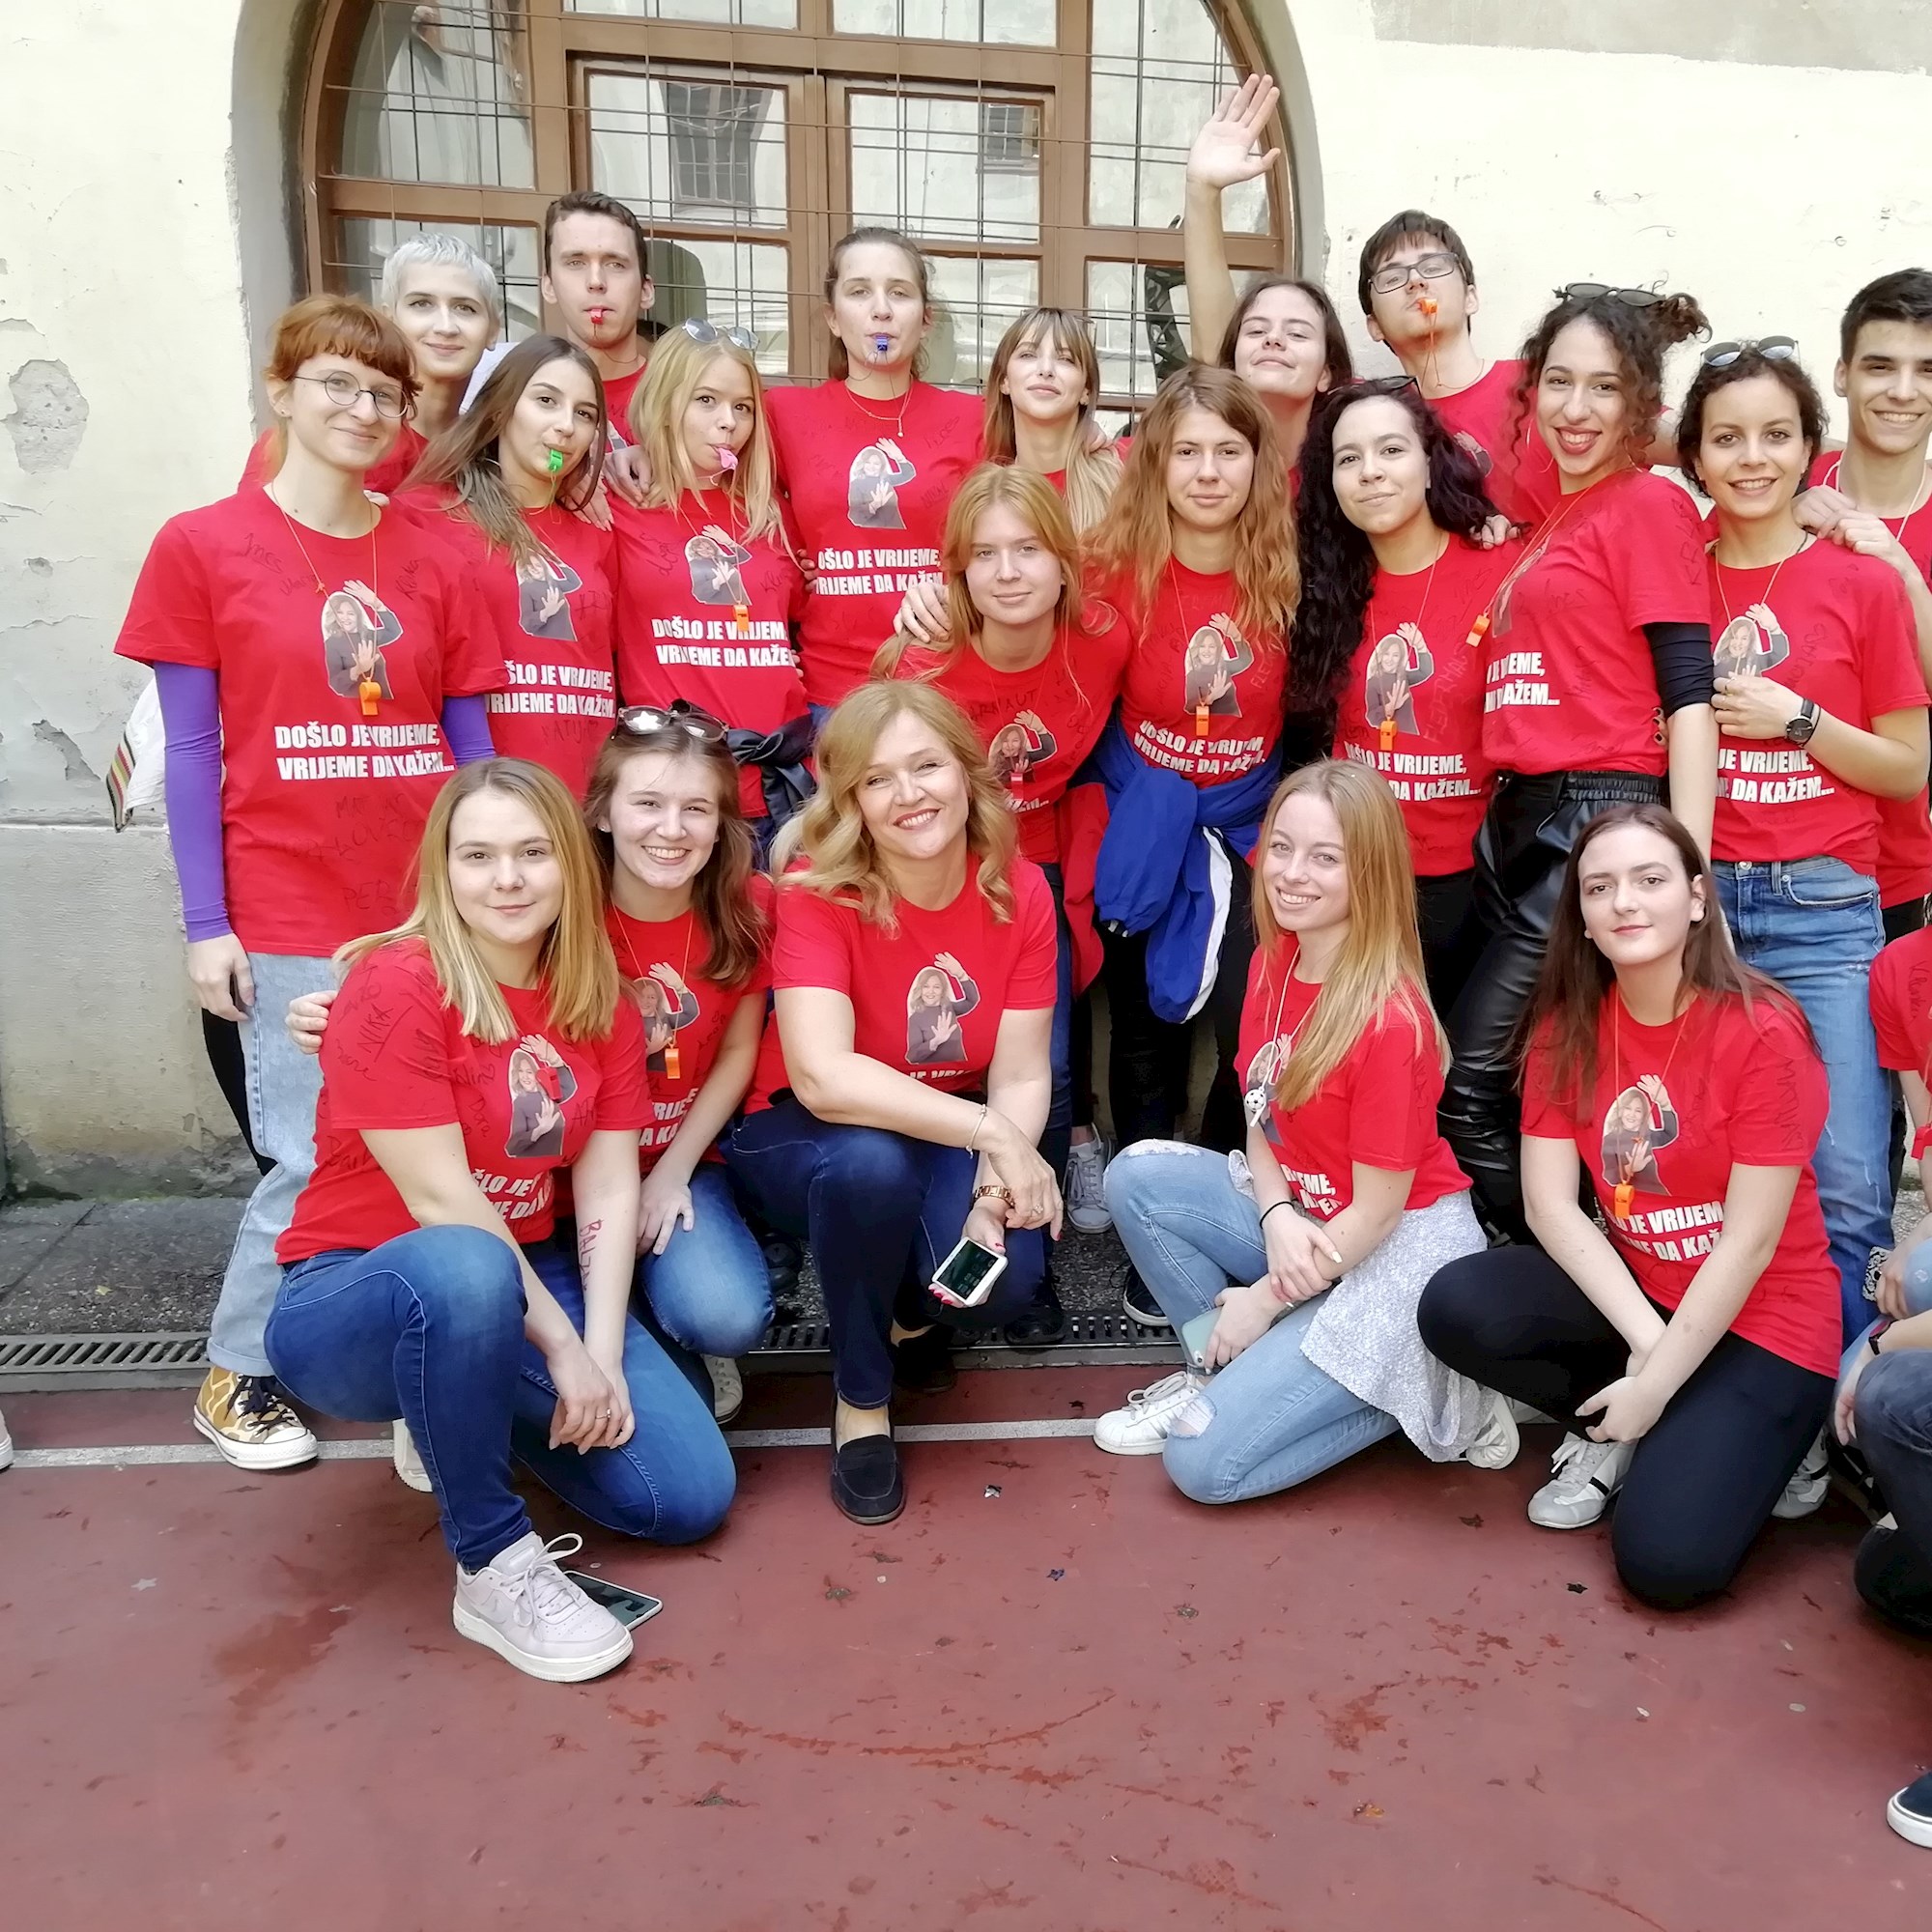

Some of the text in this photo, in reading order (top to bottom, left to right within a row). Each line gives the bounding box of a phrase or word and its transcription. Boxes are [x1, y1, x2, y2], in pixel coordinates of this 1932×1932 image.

[818, 548, 854, 570] OŠLO
[858, 549, 873, 568] JE
[873, 574, 895, 593] DA
[651, 615, 703, 639] DOŠLO
[706, 620, 724, 640] JE
[724, 647, 748, 668] DA
[503, 660, 538, 685] ŠLO
[540, 664, 557, 686] JE
[556, 694, 577, 715] DA
[273, 721, 440, 749] DOŠLO JE VRIJEME,
[1186, 738, 1206, 756] JE
[1133, 732, 1195, 773] VRIJEME
[1197, 758, 1220, 775] DA
[1378, 751, 1392, 772] JE
[1393, 753, 1467, 776] VRIJEME,
[276, 755, 368, 781] VRIJEME
[371, 754, 396, 778] DA
[1730, 777, 1758, 803] DA
[1759, 776, 1835, 804] KAŽEM...
[504, 1178, 534, 1197] JE
[1629, 1214, 1649, 1235] JE
[1646, 1201, 1724, 1235] VRIJEM
[1652, 1240, 1682, 1262] DA
